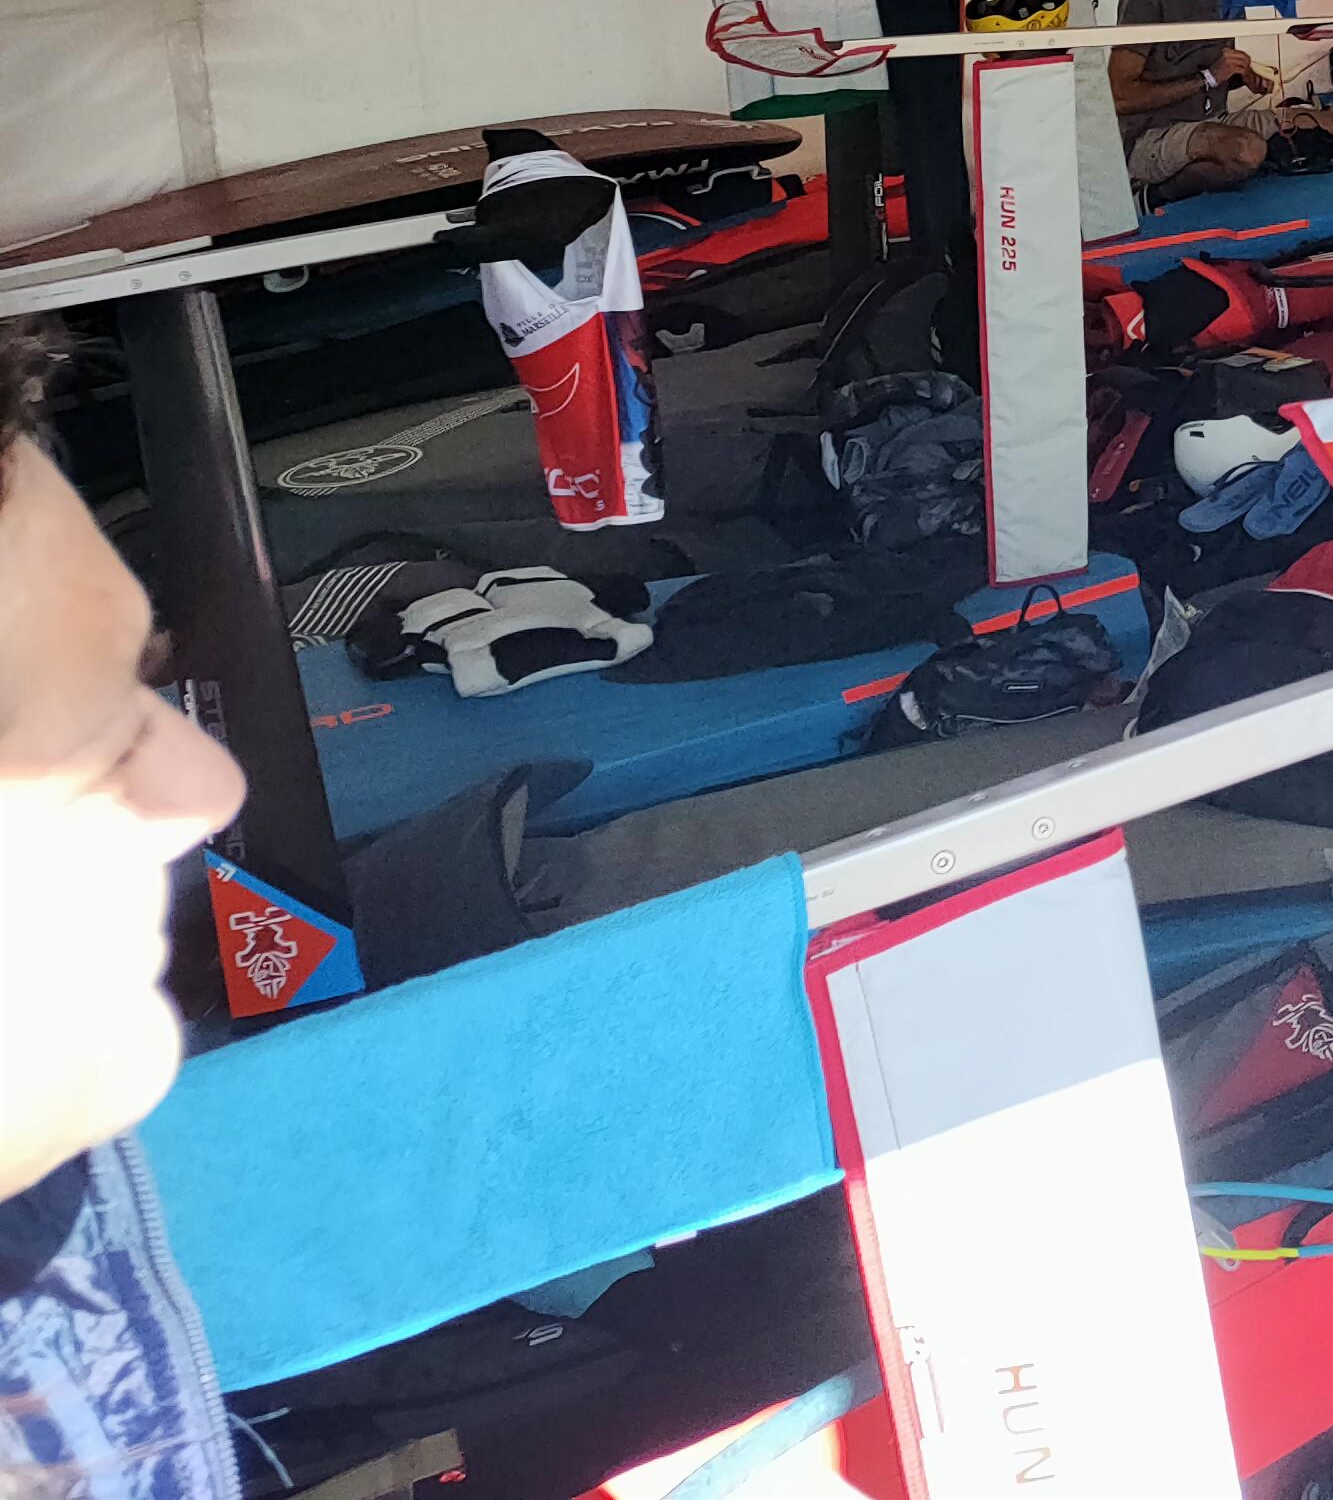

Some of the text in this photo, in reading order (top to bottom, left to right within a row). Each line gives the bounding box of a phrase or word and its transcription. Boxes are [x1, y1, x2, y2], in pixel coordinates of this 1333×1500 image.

[1000, 186, 1017, 272] HUN 225
[994, 1362, 1056, 1485] HUN
